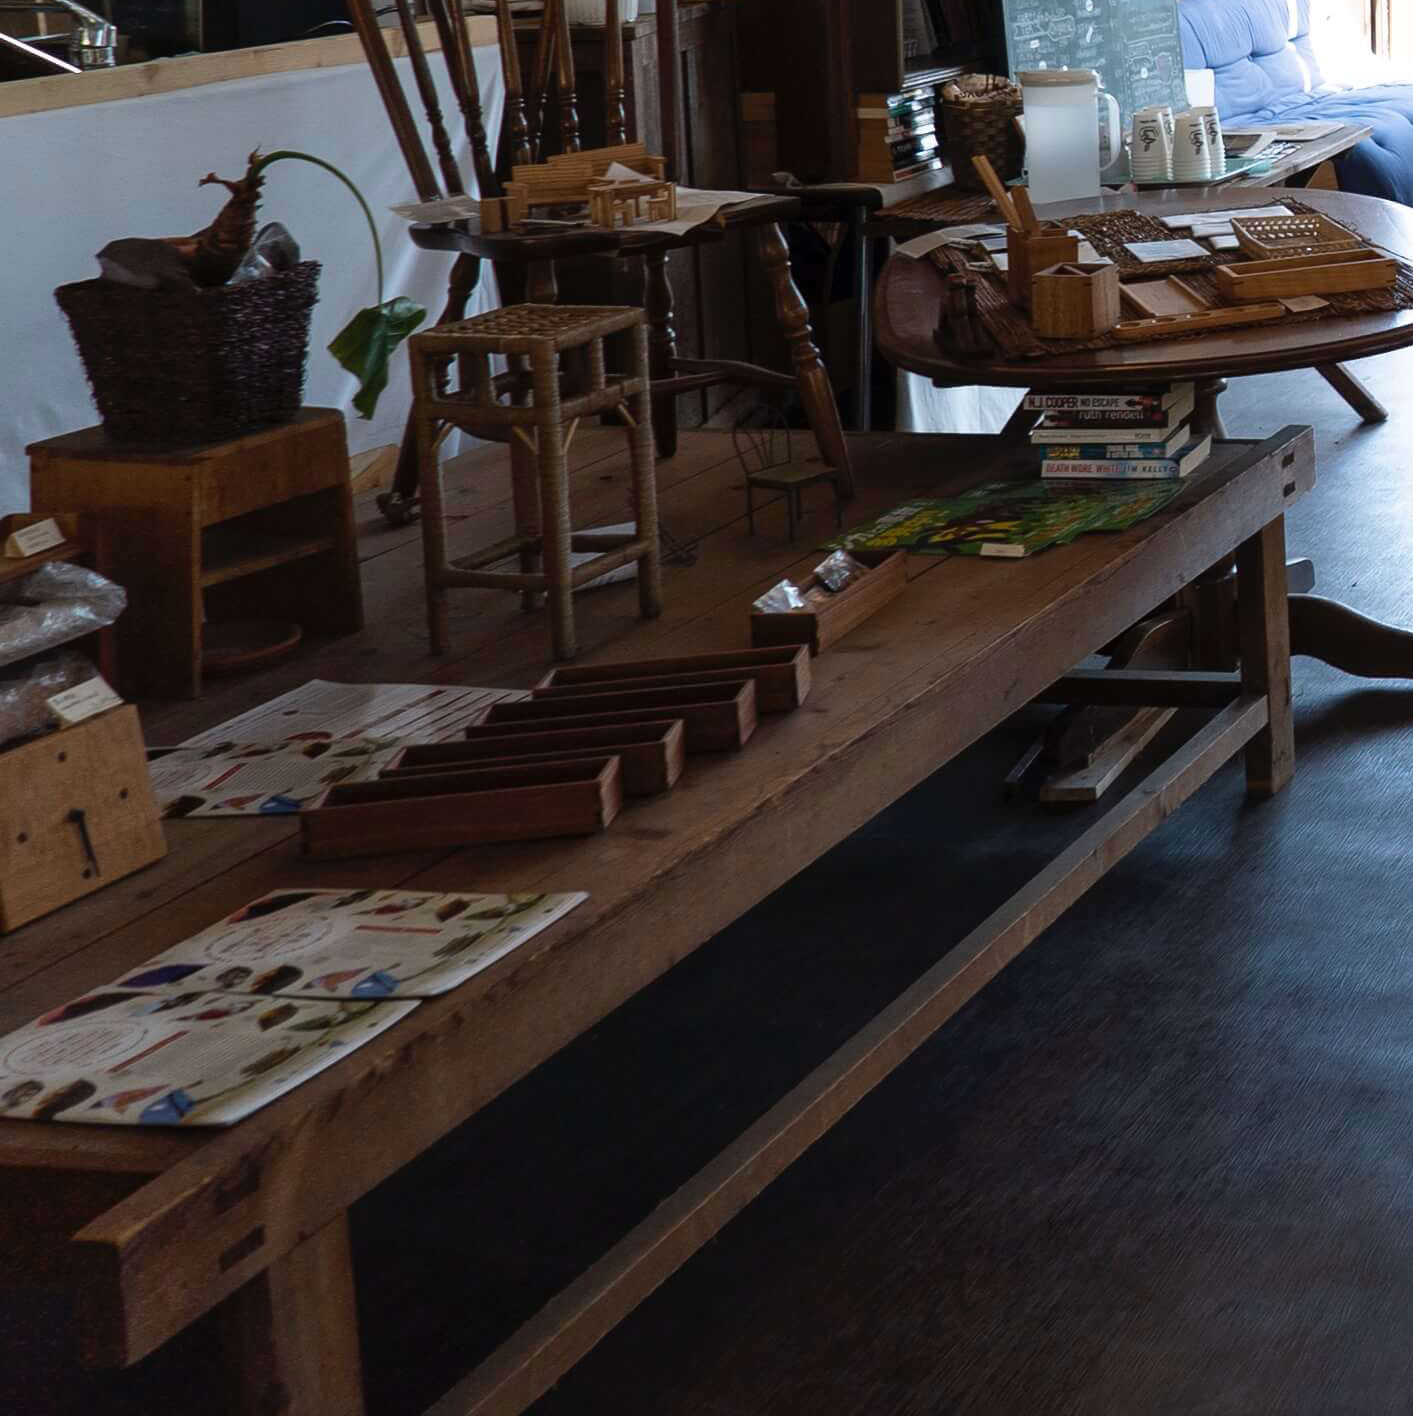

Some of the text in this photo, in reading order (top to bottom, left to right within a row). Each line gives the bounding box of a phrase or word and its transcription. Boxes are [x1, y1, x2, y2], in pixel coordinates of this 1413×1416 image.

[1046, 396, 1079, 408] COOPER
[1080, 397, 1090, 408] NO
[1092, 397, 1121, 408] ESCAPE
[1079, 410, 1144, 420] ruth rendell
[1046, 463, 1071, 473] DEATH
[1071, 463, 1093, 473] WORE
[1096, 463, 1120, 473] WHITE
[1142, 464, 1169, 473] KELLY
